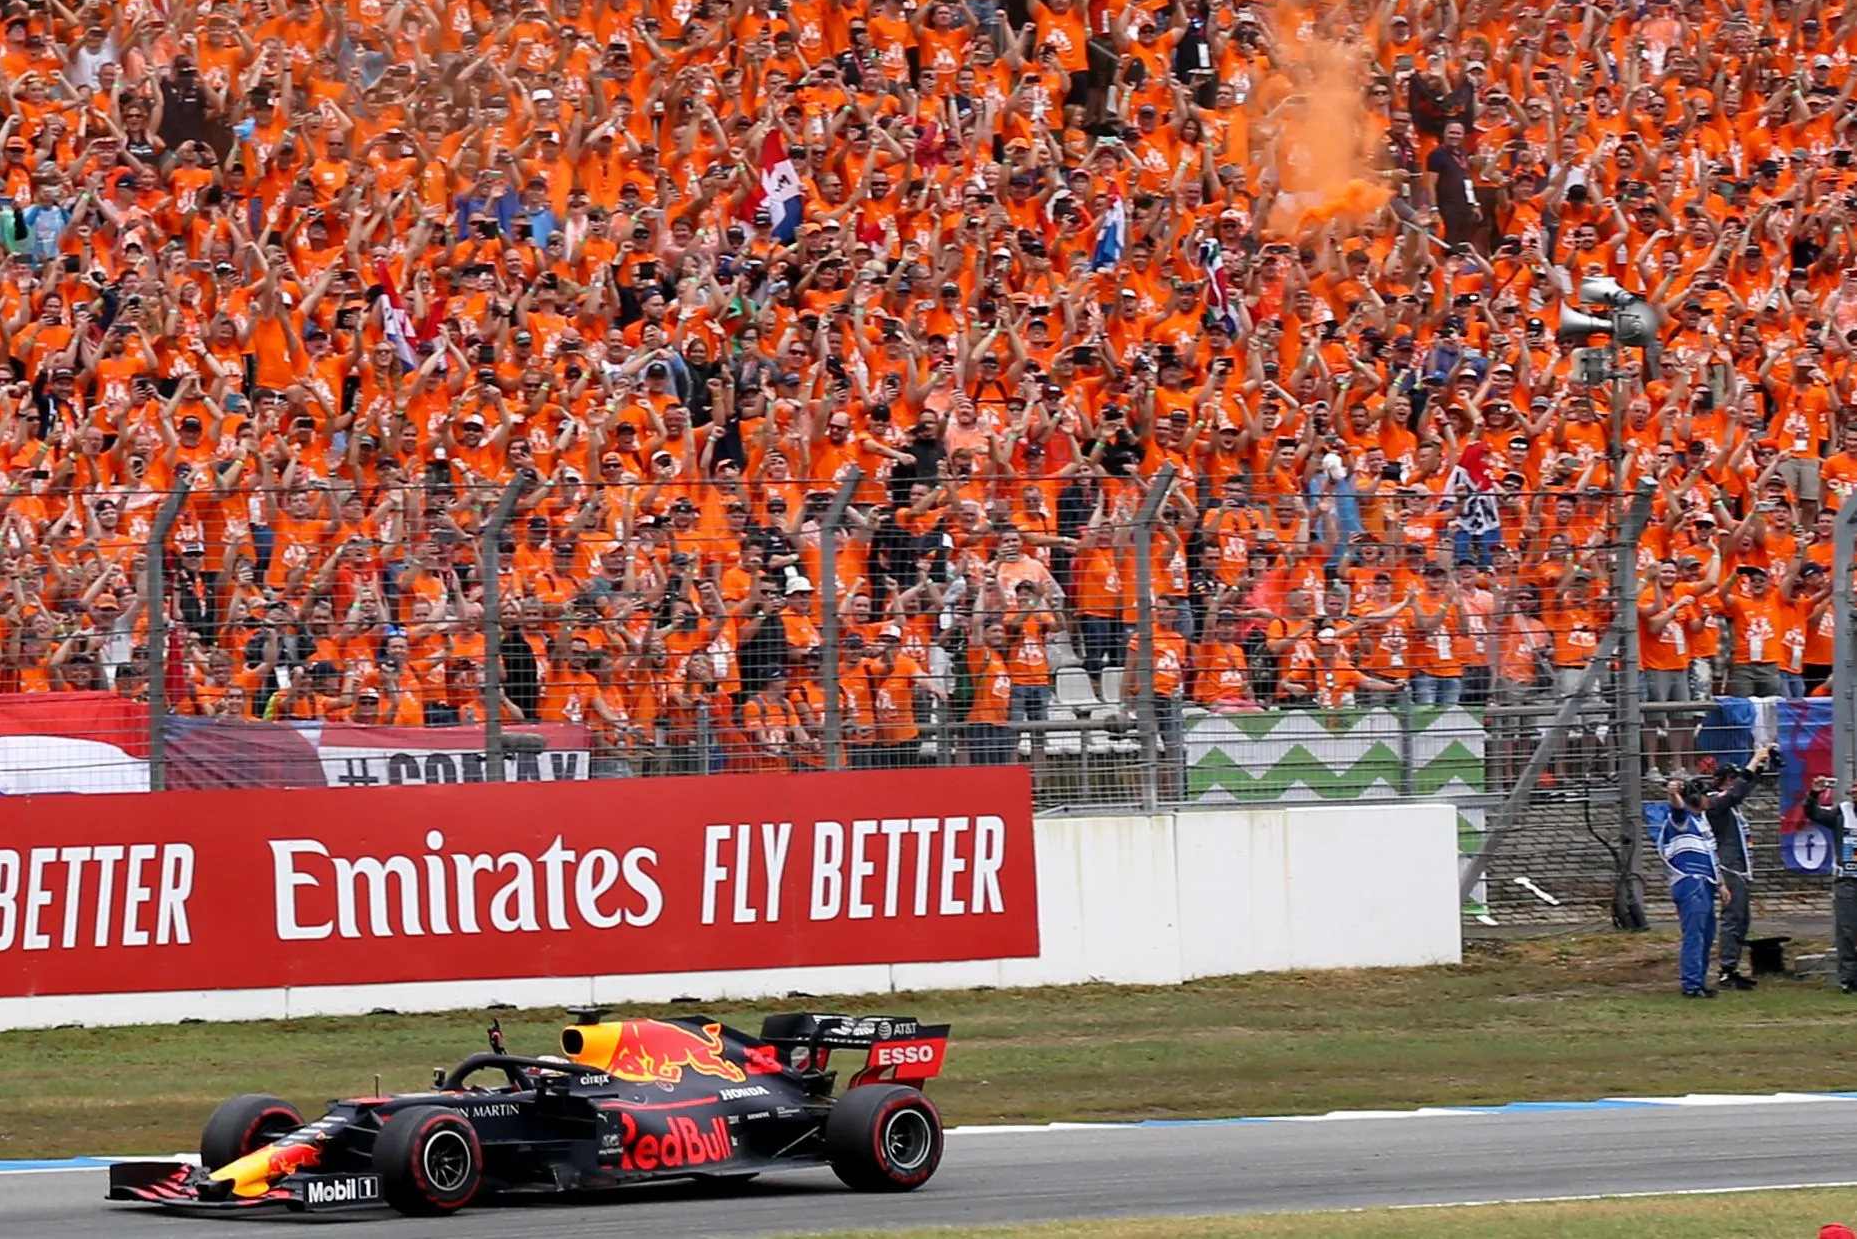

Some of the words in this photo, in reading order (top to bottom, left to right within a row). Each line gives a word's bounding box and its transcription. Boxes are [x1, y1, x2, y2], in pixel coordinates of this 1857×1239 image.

[268, 829, 664, 941] Emirates
[701, 822, 793, 926] FLY
[810, 815, 1005, 921] BETTER
[894, 1022, 917, 1036] AT&T
[878, 1045, 934, 1066] ESSO
[719, 1086, 771, 1101] HONDA
[473, 1104, 520, 1118] MARTIN
[308, 1178, 356, 1204] Mobil
